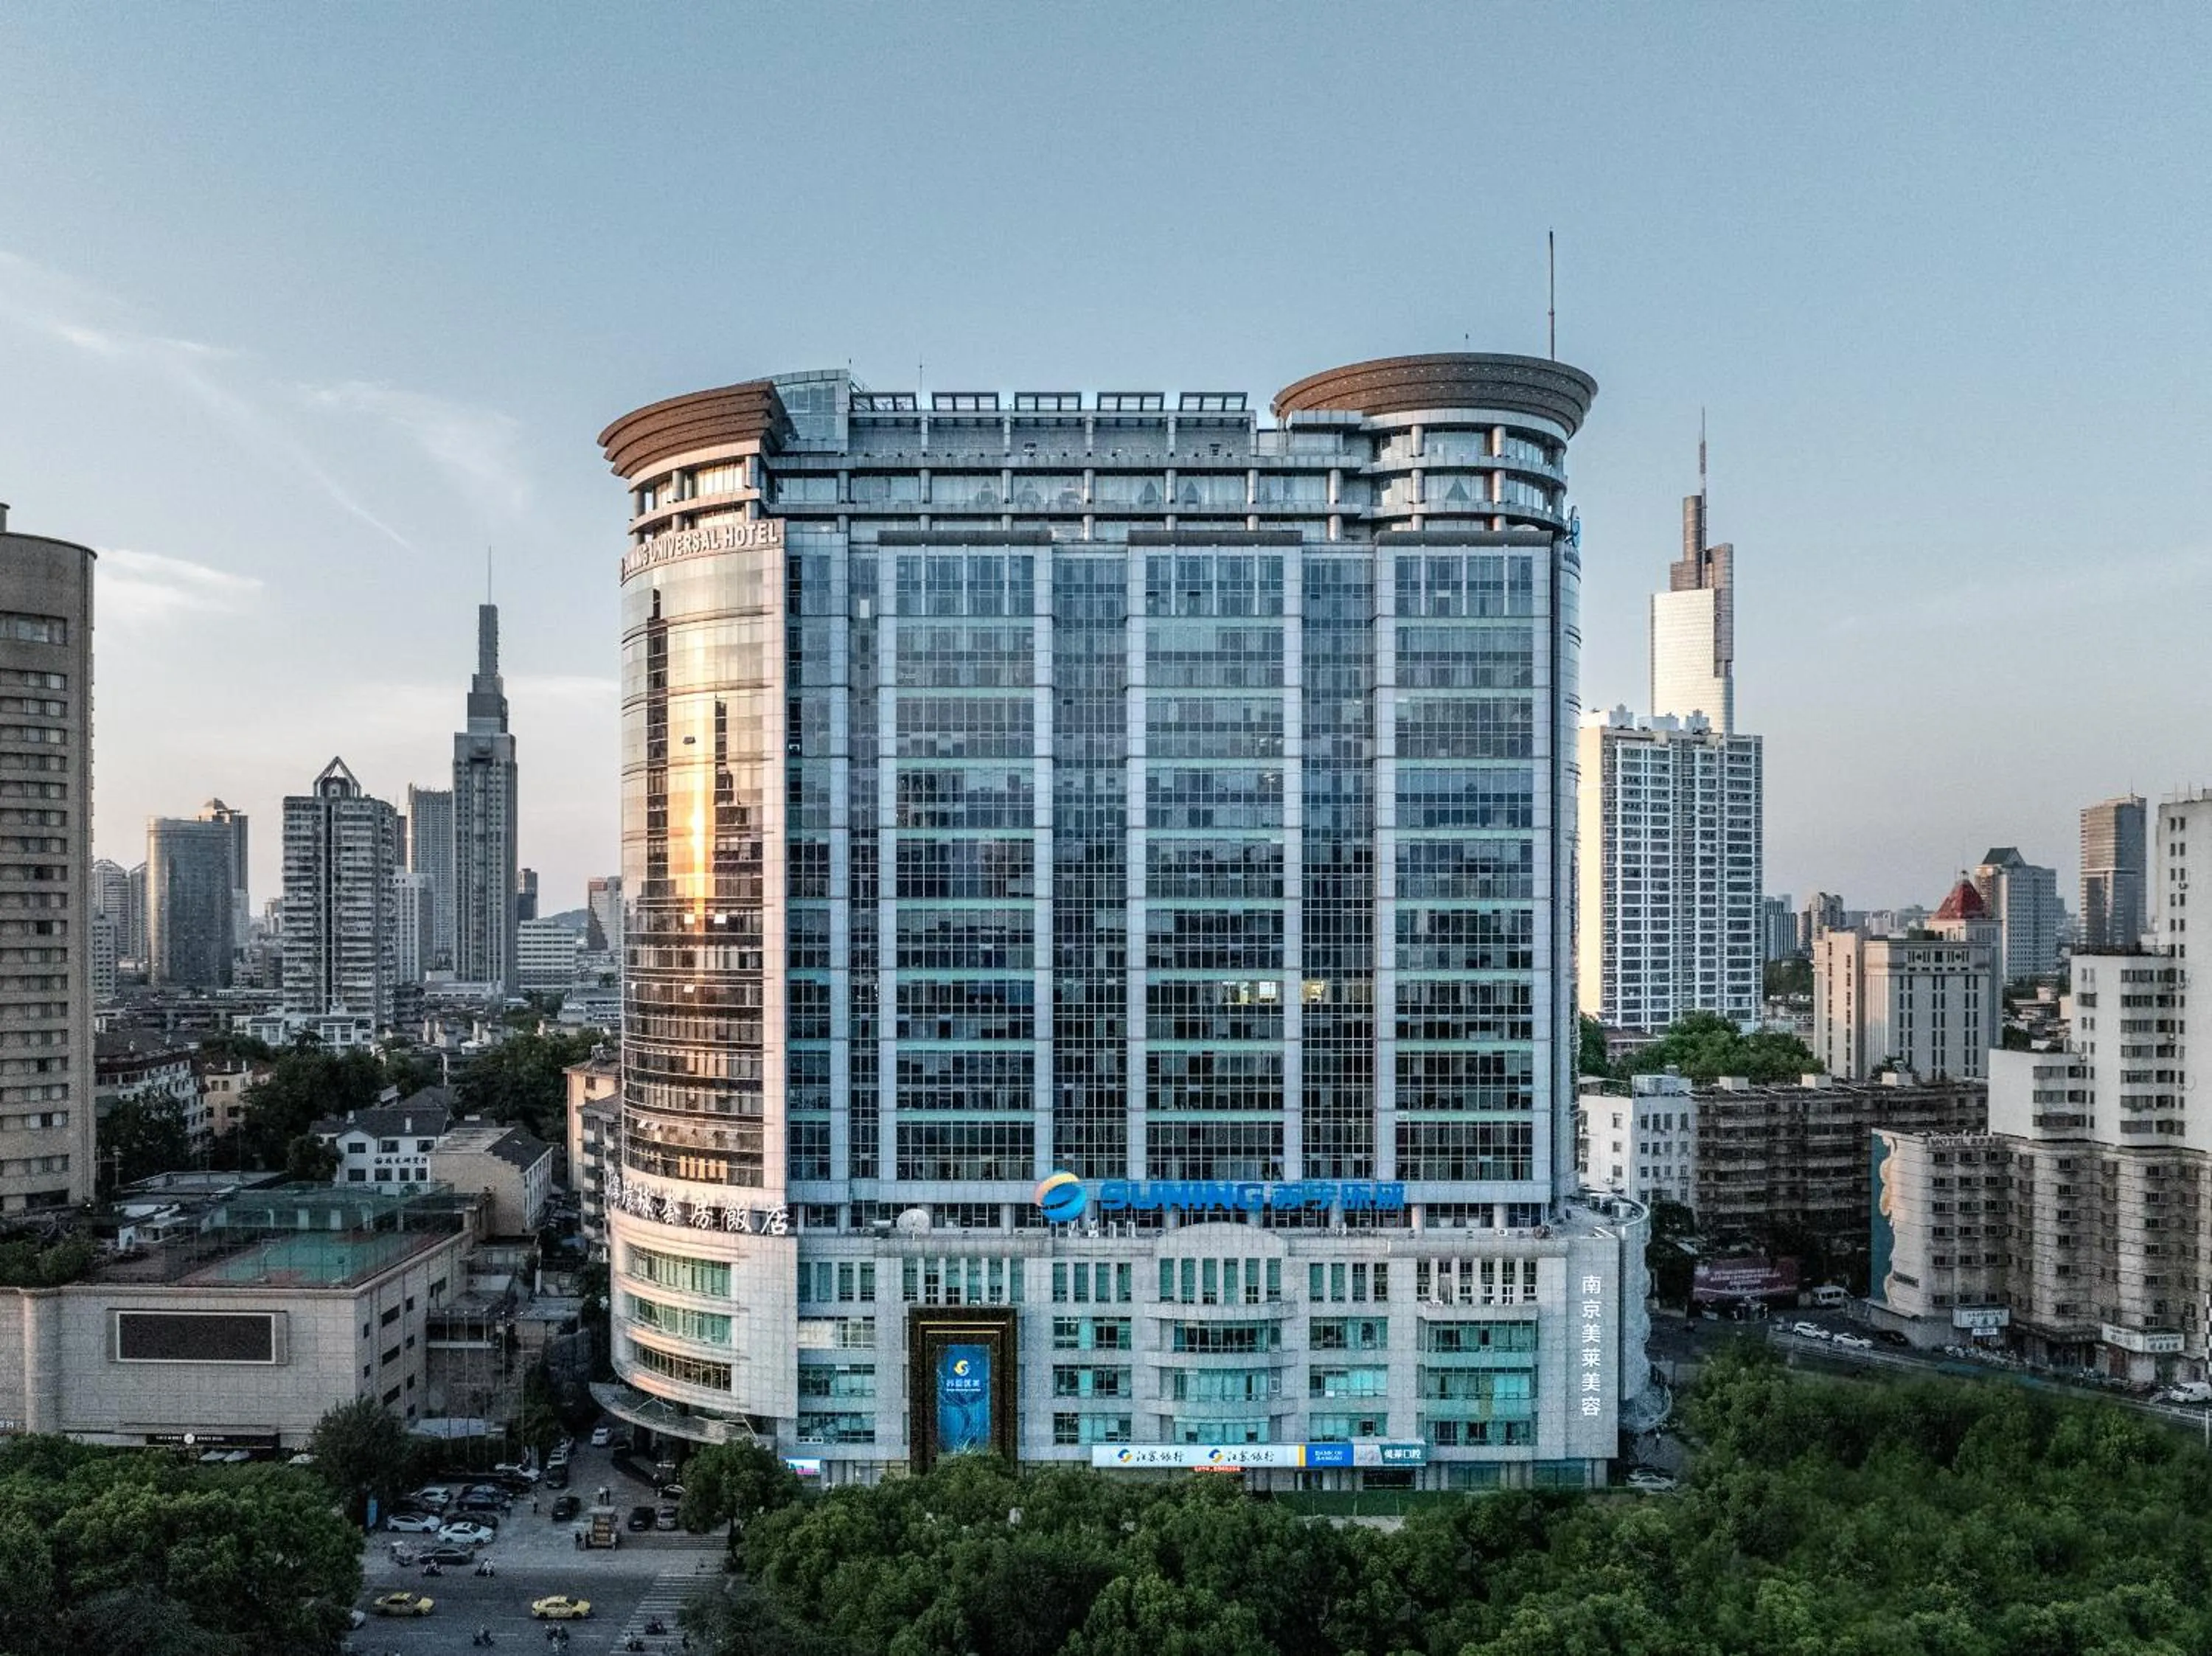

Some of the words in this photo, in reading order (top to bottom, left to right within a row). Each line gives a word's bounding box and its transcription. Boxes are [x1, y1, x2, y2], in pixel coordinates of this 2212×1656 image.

[649, 526, 720, 563] UNIVERSAL
[725, 521, 779, 548] HOTEL
[1100, 1181, 1264, 1211] SUNING
[1581, 1274, 1602, 1416] 南京美莱美容
[1136, 1450, 1185, 1463] 江苏银行
[1228, 1450, 1275, 1463] 江苏银行
